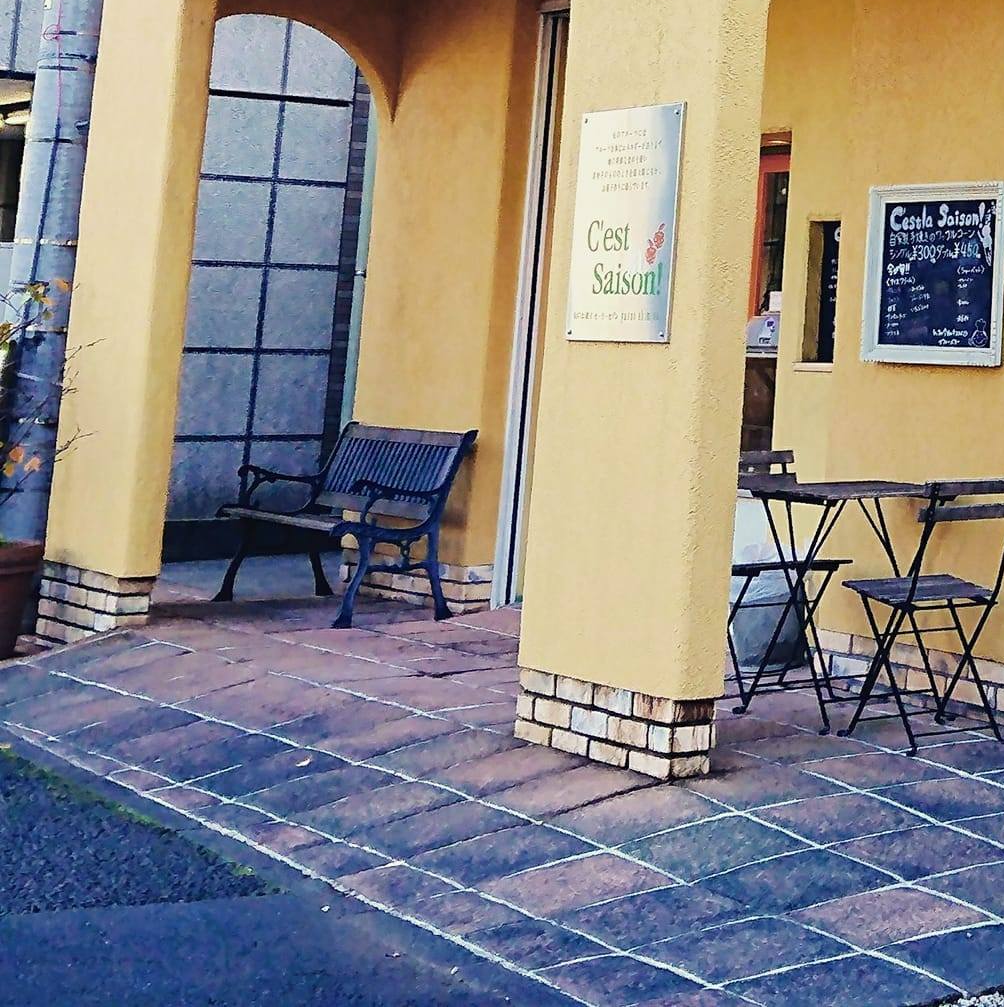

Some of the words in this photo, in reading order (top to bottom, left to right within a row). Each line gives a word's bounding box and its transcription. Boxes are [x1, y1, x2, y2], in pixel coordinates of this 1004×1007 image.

[937, 201, 985, 229] Saison!
[587, 220, 631, 252] C'est
[591, 262, 663, 296] Saison!
